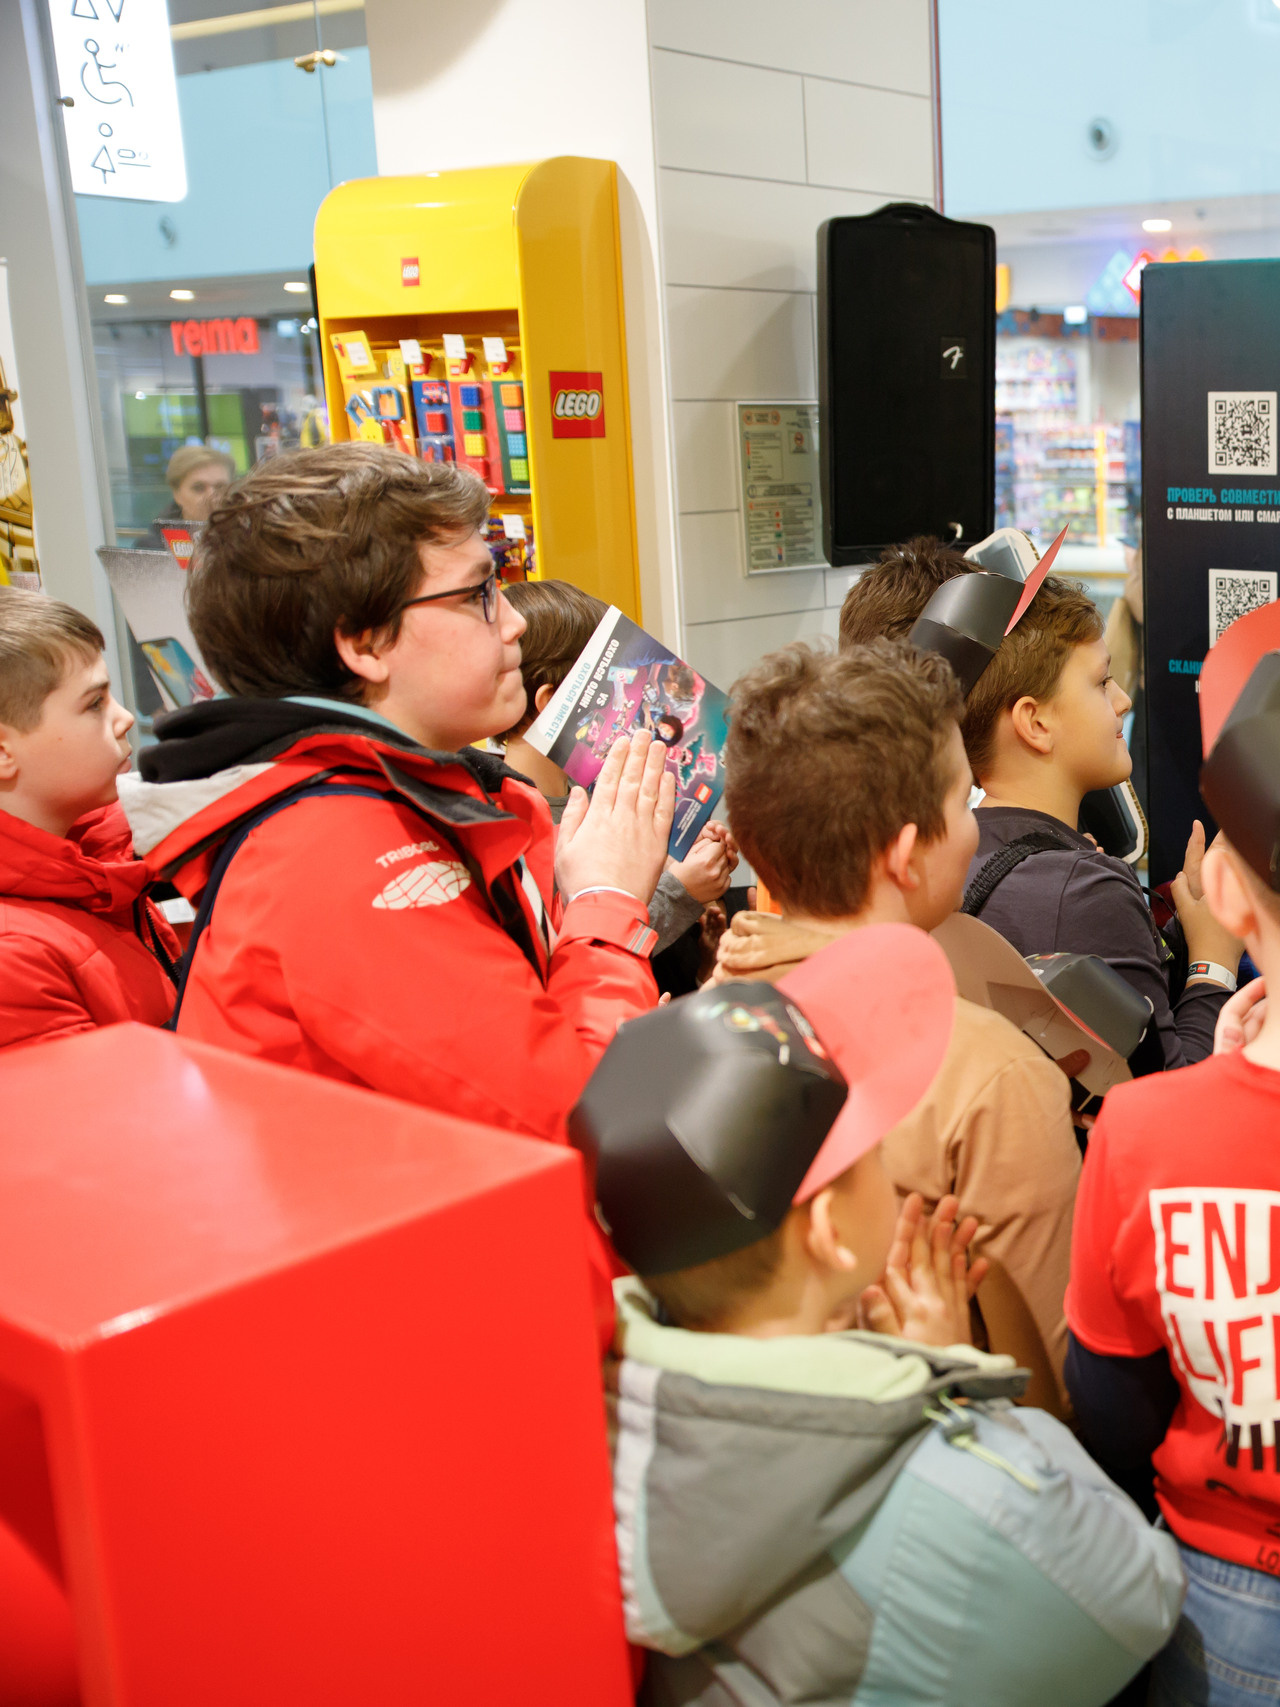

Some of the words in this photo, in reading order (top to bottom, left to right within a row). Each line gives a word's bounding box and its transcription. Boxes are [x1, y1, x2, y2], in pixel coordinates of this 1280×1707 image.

[554, 391, 601, 418] LEGO
[1167, 487, 1217, 503] ПРОВЕРЬ
[1167, 507, 1174, 520] С
[1176, 508, 1232, 522] ПЛАНШЕТОМ
[1235, 509, 1254, 523] ИЛИ
[596, 692, 609, 706] VS
